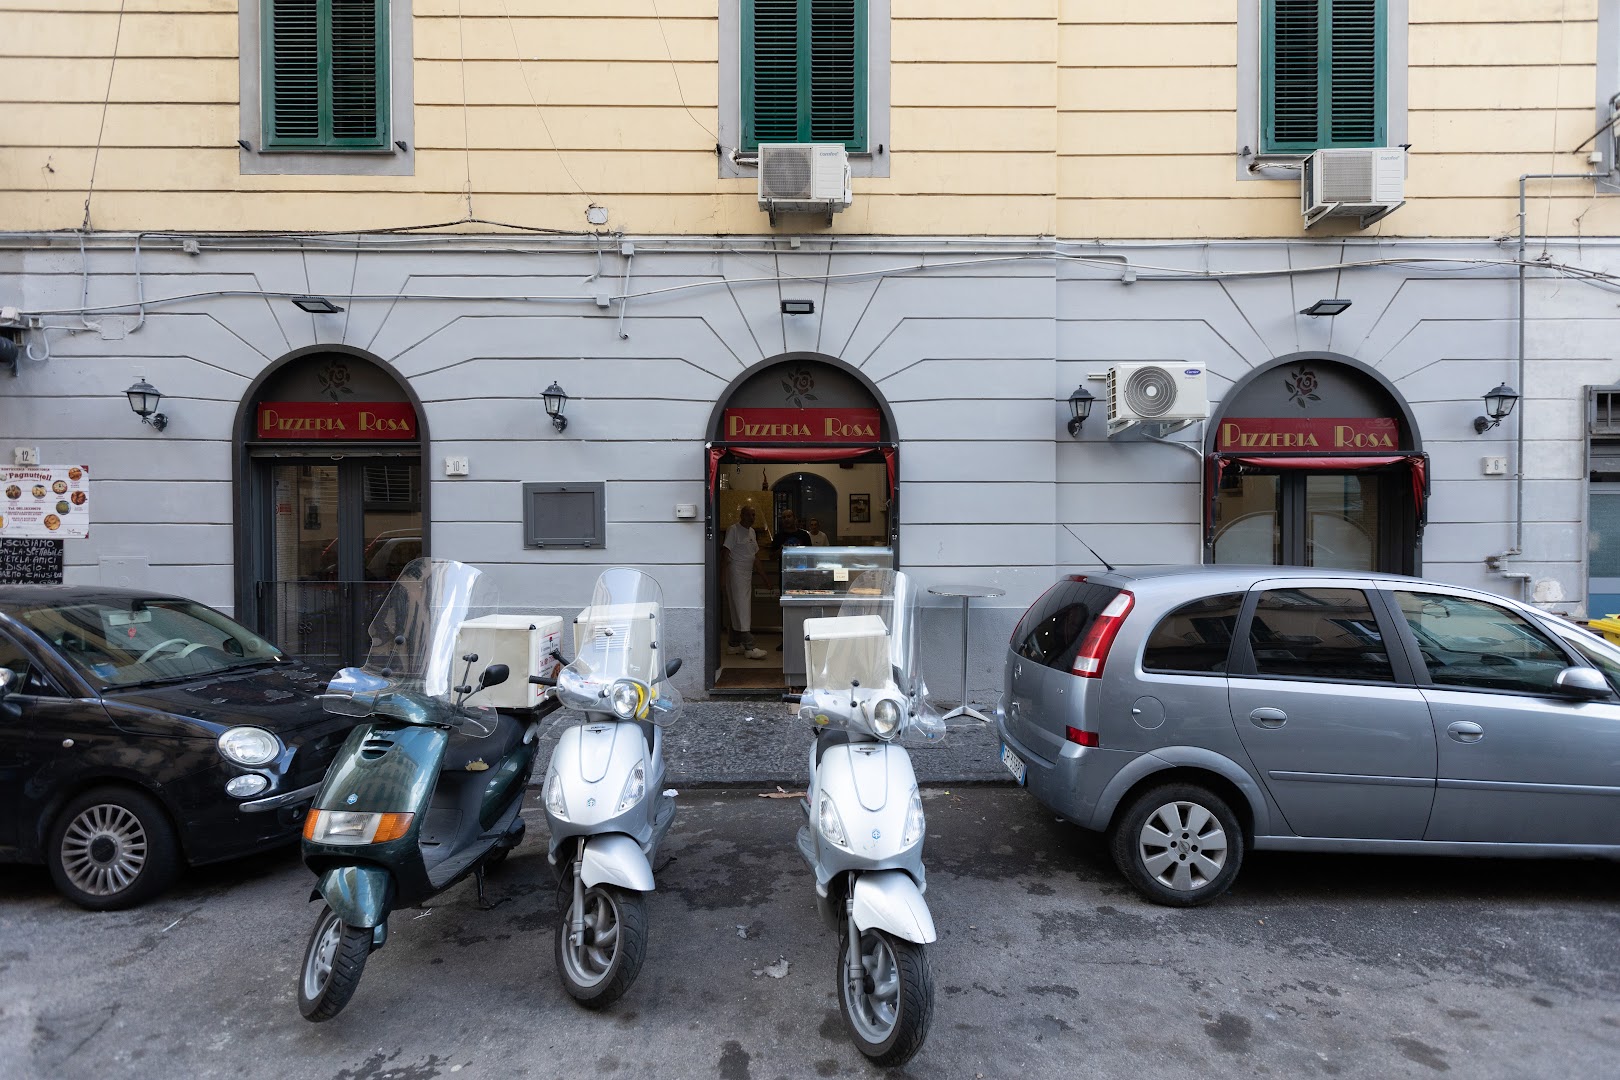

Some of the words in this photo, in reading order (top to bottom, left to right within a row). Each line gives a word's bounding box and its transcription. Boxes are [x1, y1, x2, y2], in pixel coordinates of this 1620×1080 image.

[263, 409, 346, 430] PIZZERIA
[359, 412, 410, 430] ROSA
[730, 416, 811, 436] PIZZERIA
[825, 418, 875, 437] ROSA
[1222, 423, 1319, 447] PIZZERIA
[1334, 426, 1394, 448] ROSA
[22, 450, 29, 461] 12
[453, 461, 459, 471] 10
[1494, 460, 1498, 470] 6
